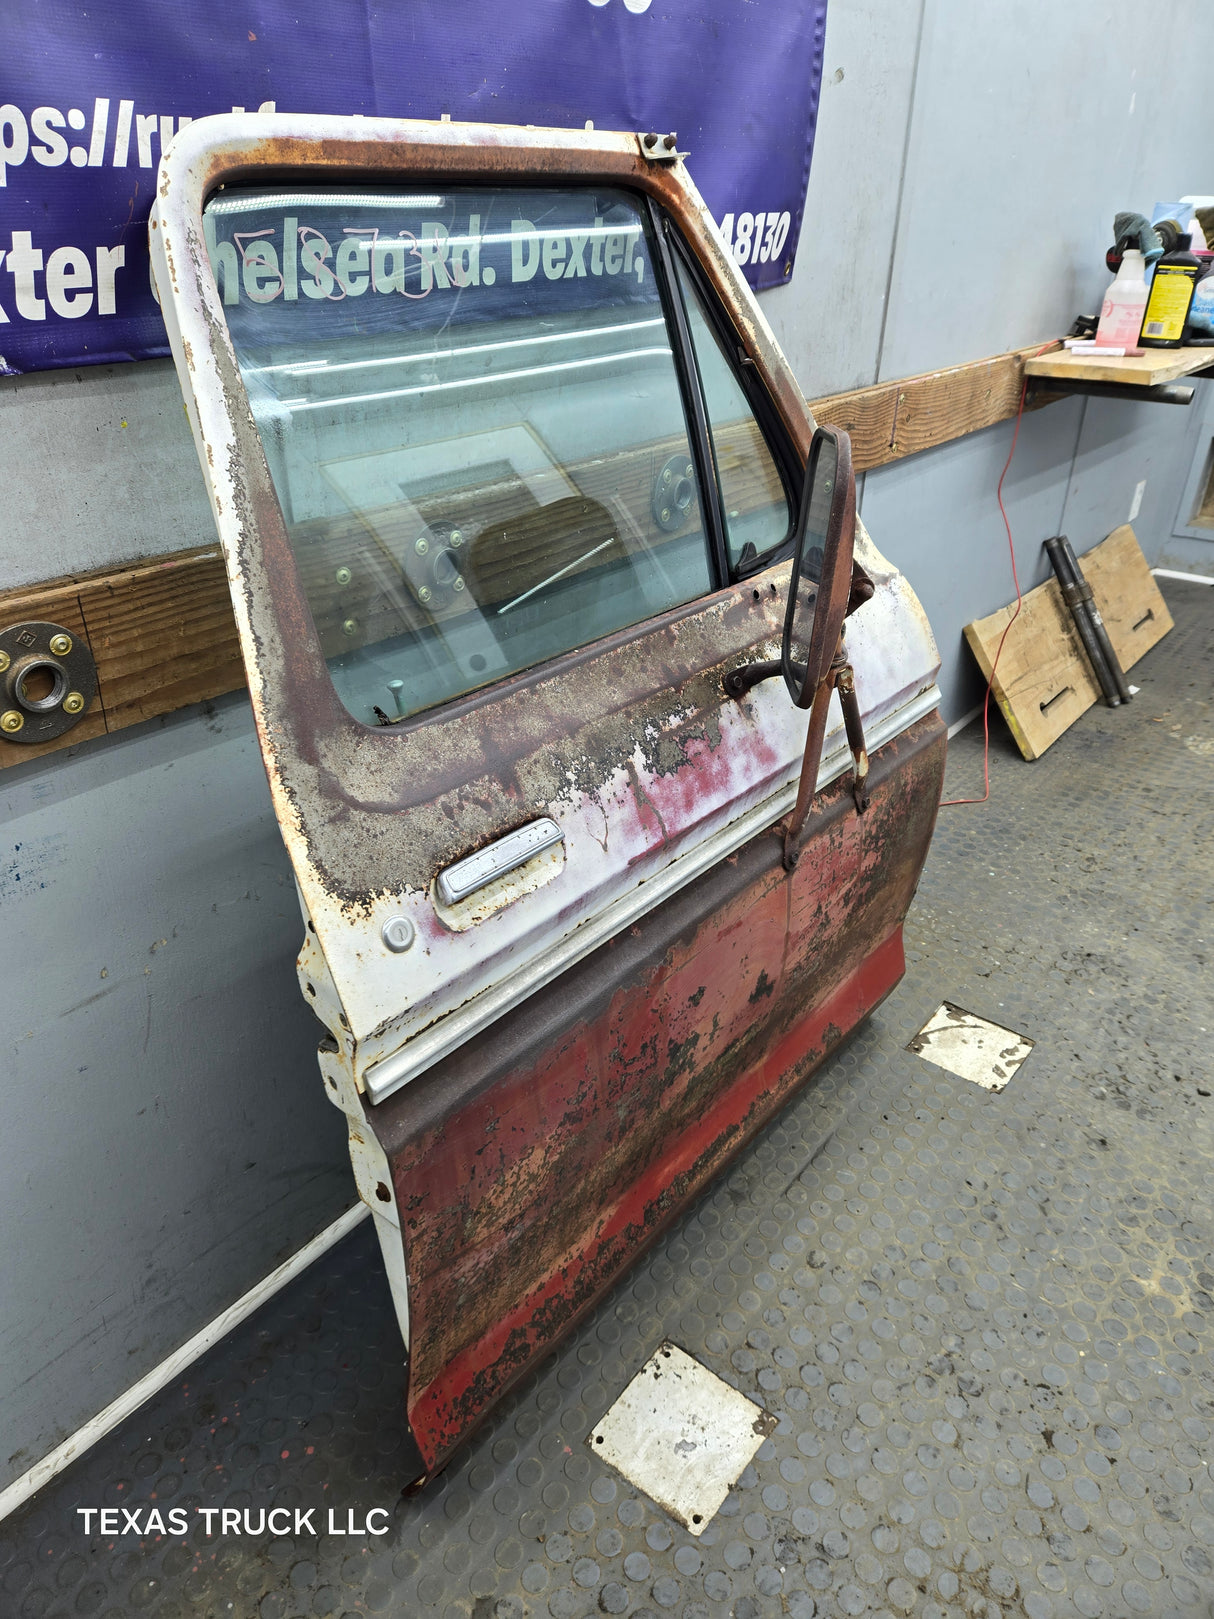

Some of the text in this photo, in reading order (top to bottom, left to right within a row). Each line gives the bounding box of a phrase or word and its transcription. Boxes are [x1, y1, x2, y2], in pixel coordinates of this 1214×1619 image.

[421, 214, 496, 290] Rd.
[511, 217, 645, 284] Dexter,
[720, 211, 791, 266] 48130
